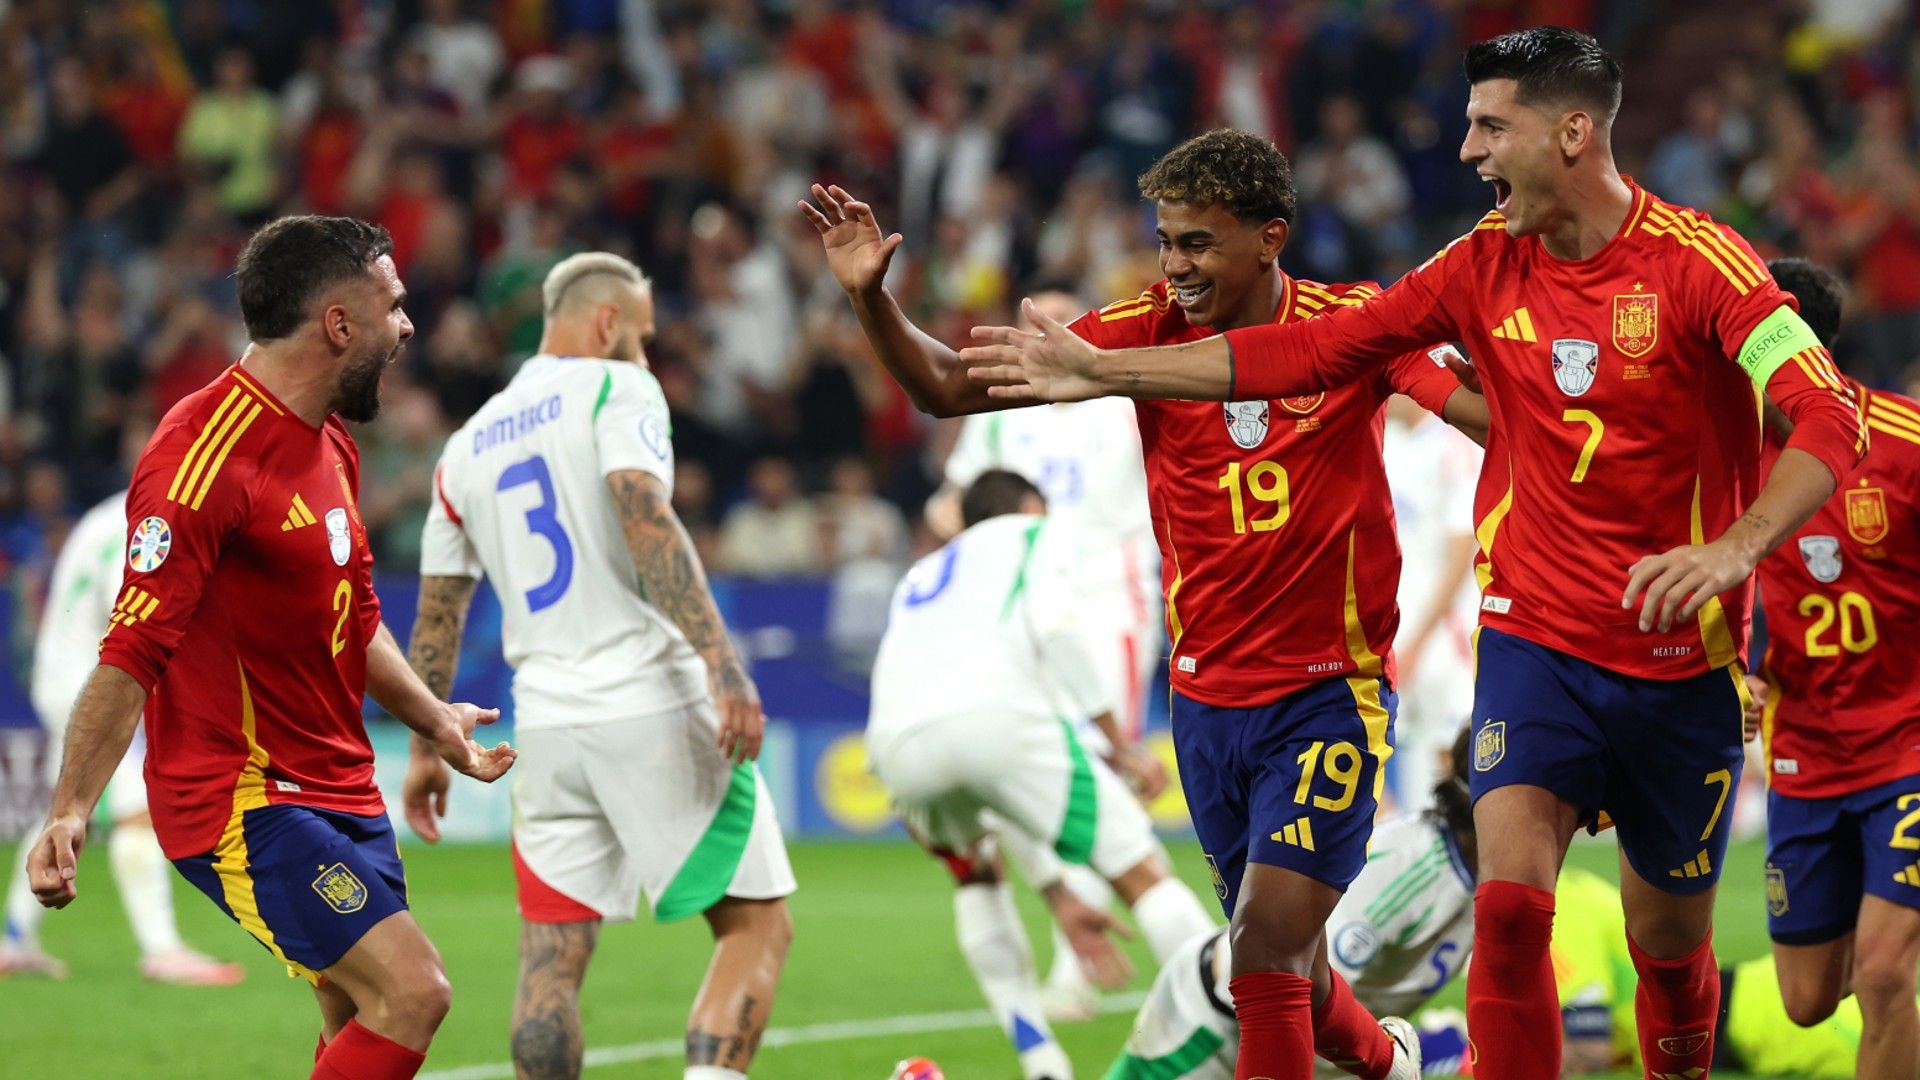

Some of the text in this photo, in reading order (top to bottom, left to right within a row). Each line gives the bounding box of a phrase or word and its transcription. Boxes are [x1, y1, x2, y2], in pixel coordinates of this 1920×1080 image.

[1746, 325, 1793, 367] RESPECT
[1561, 409, 1605, 483] 7
[1218, 460, 1290, 534] 19
[496, 455, 574, 614] 3
[332, 578, 352, 658] 2
[1798, 591, 1878, 658] 20
[1293, 740, 1363, 812] 19
[1699, 767, 1732, 841] 7
